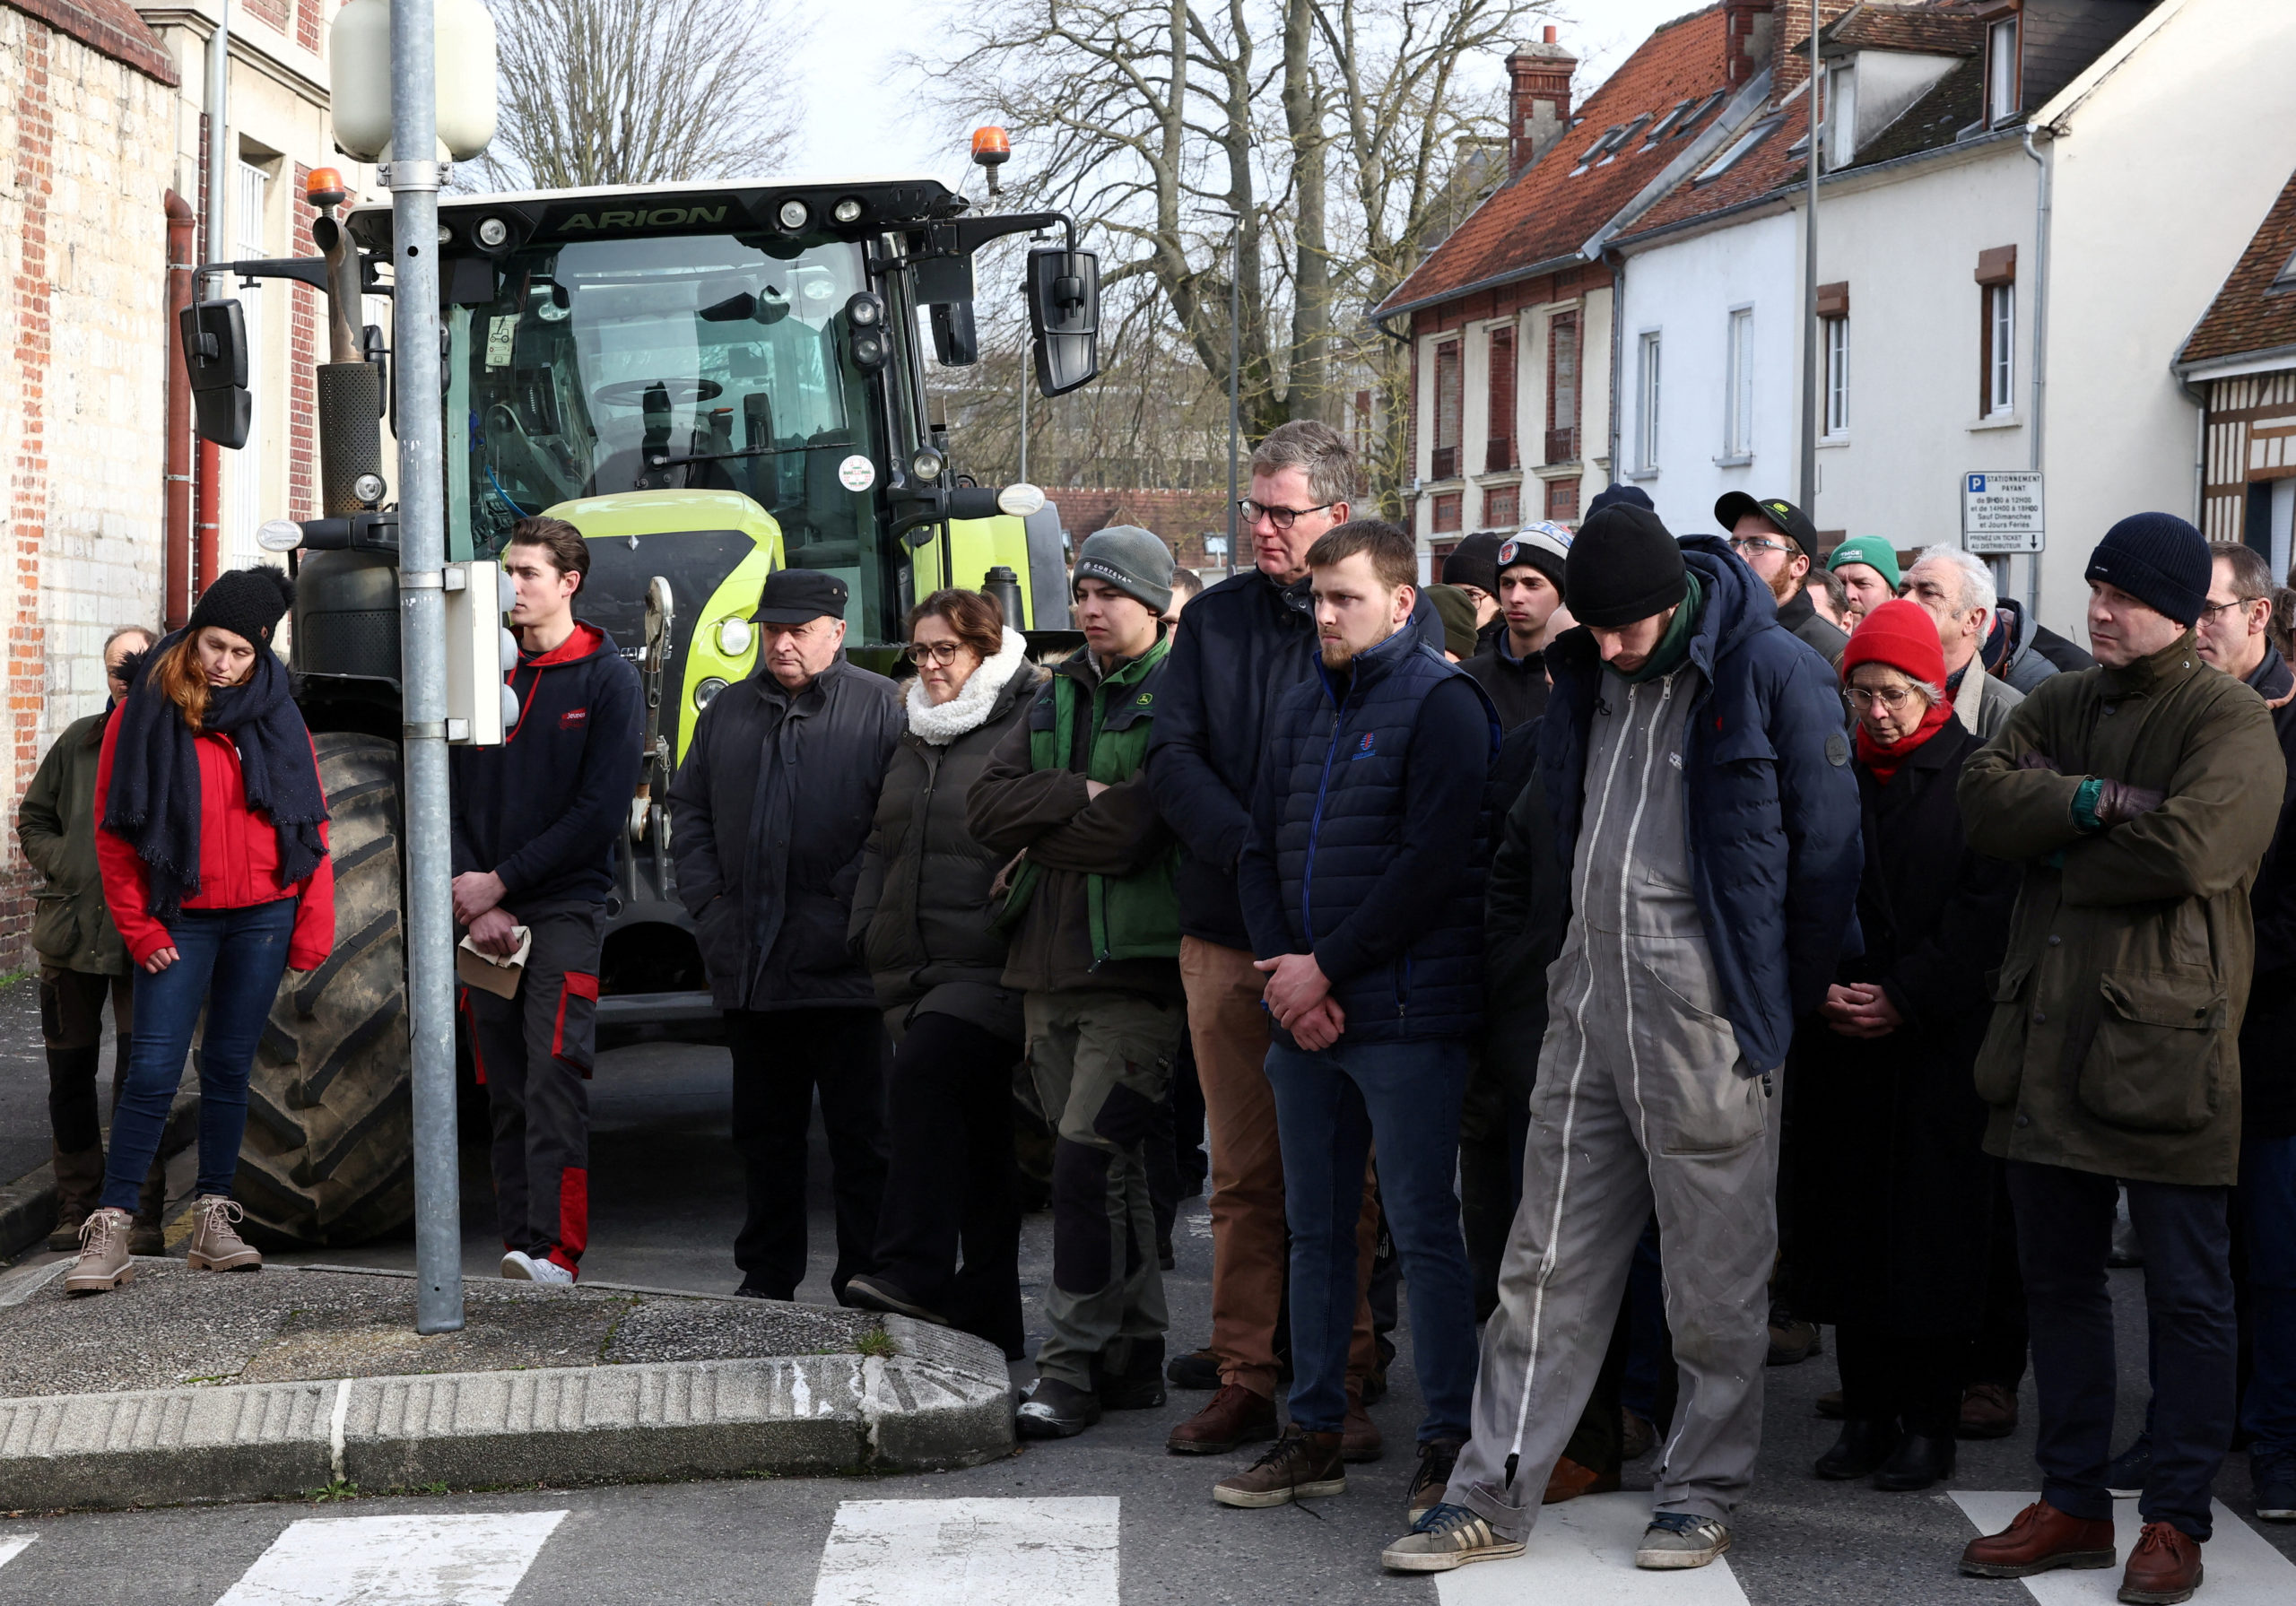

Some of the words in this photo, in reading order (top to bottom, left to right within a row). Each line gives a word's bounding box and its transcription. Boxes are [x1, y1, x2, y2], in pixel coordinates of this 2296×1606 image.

[557, 206, 727, 230] ARION
[1972, 477, 1982, 490] P
[2009, 520, 2030, 528] Fériés
[1093, 563, 1127, 583] CORTEVA
